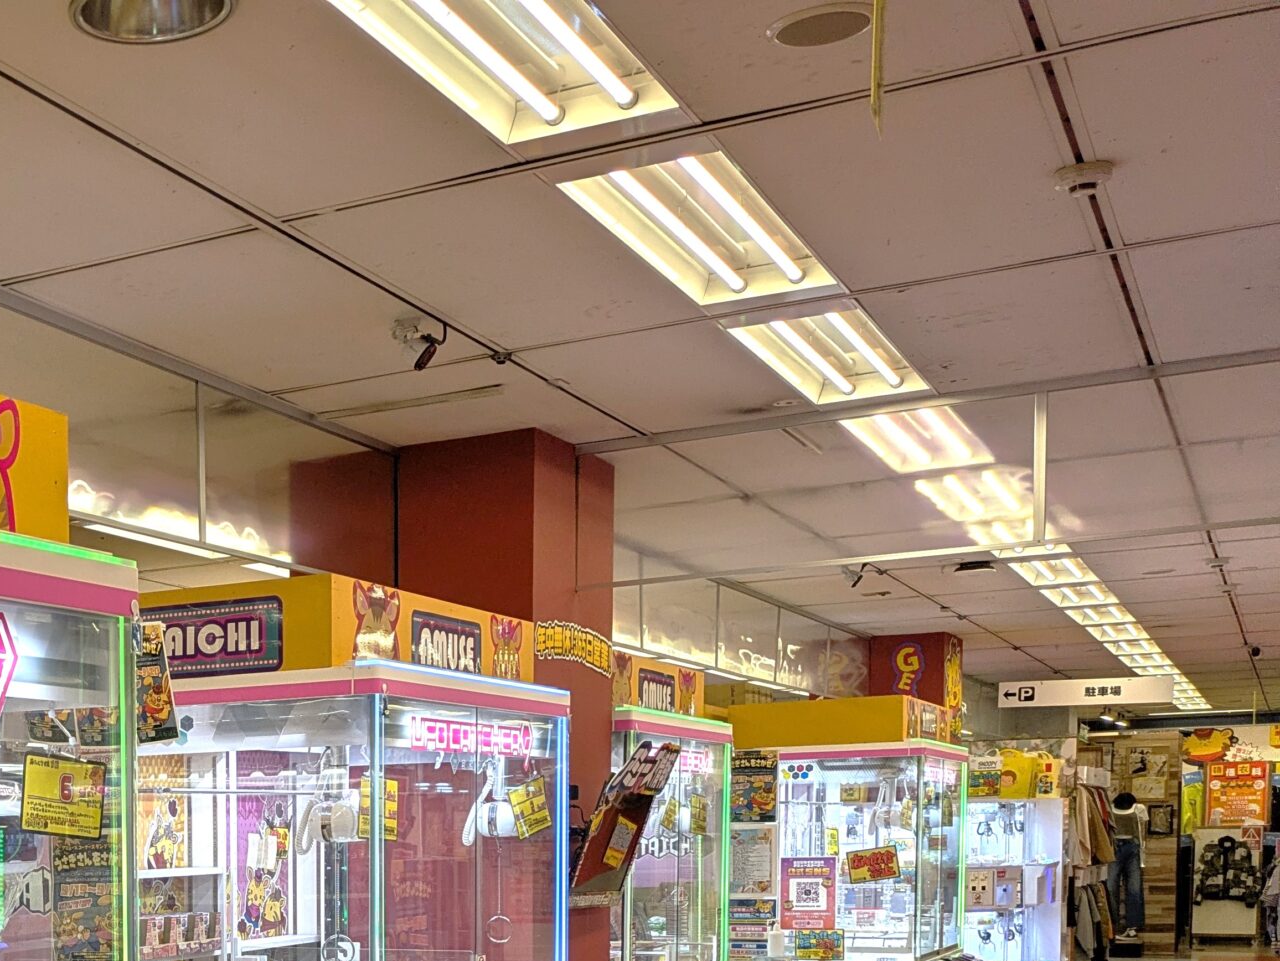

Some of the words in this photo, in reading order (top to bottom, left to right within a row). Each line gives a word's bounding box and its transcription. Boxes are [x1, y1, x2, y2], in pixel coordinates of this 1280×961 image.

[419, 627, 475, 672] AMUSE
[1084, 685, 1122, 698] 駐車場
